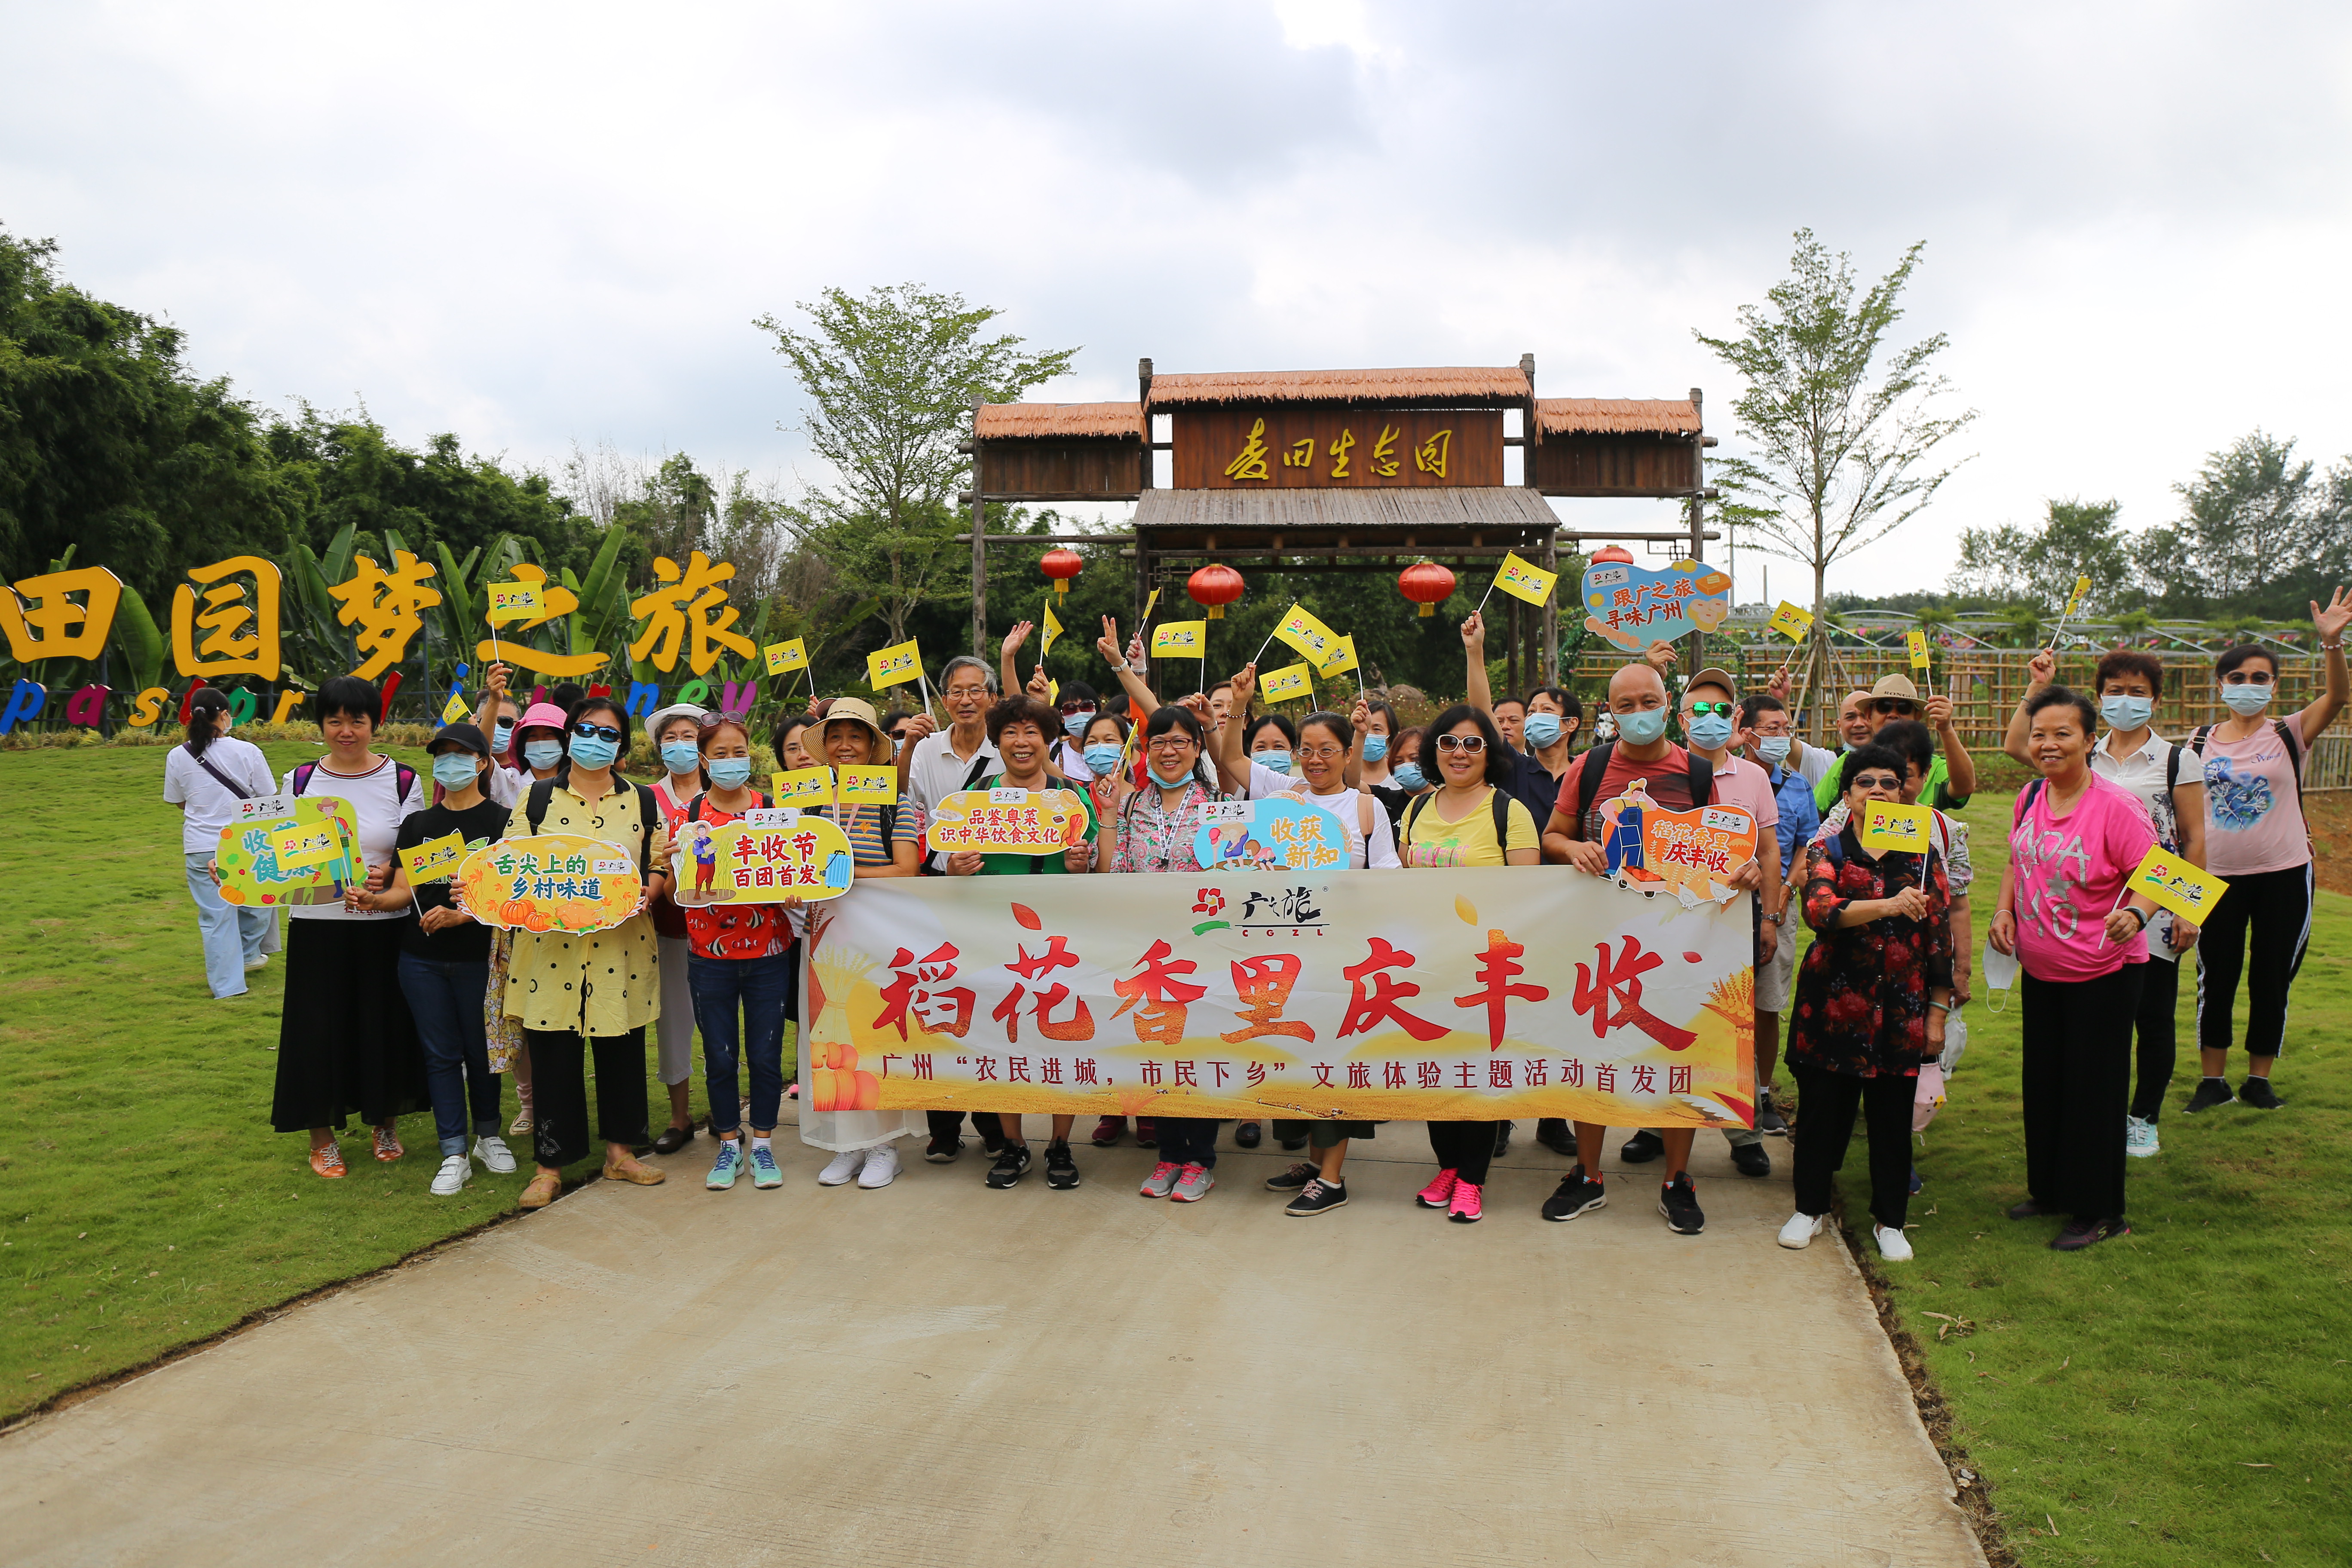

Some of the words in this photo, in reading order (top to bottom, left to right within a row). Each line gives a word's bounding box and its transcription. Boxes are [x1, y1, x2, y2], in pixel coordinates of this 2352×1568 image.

[1613, 579, 1696, 607] 跟广之旅
[0, 549, 756, 681] 田园梦之旅
[1605, 600, 1683, 630] 寻味广州
[969, 808, 1041, 826] 品鉴粤菜
[1271, 816, 1326, 843] 收获
[732, 832, 818, 865] 丰收节
[940, 826, 1060, 844] 识中华饮食文化
[1652, 821, 1729, 851] 稻花香里
[495, 854, 586, 875] 舌尖上的
[1285, 843, 1338, 869] 新知
[1664, 841, 1729, 874] 庆丰收
[510, 877, 603, 900] 乡村味道
[733, 865, 821, 887] 百团首发
[1242, 886, 1321, 923] 广之旅
[1242, 929, 1323, 937] CGZL
[873, 929, 1698, 1052] 稻花香里庆丰收
